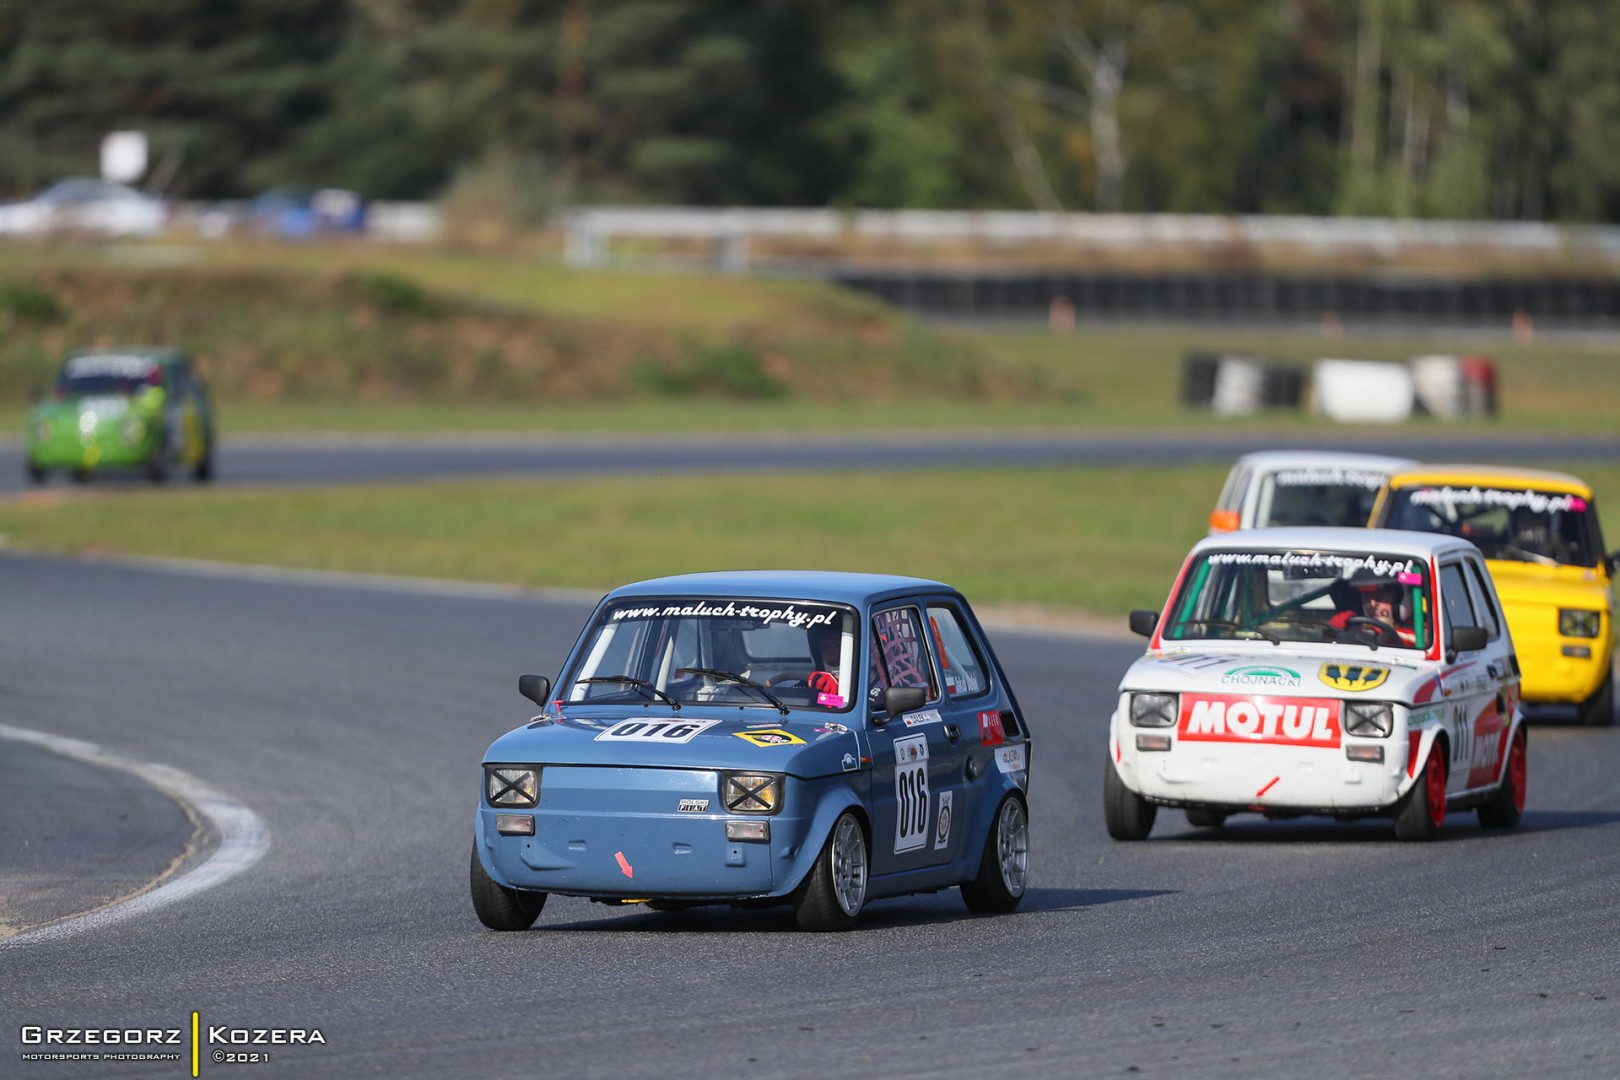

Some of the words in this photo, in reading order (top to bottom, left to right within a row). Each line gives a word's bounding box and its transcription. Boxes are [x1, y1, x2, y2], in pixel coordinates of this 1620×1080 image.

[1208, 552, 1413, 577] www.maluch-trophy.pl
[613, 601, 837, 628] www.maluch-trophy.pl
[1220, 674, 1301, 687] CHOJNACKI
[611, 722, 700, 739] 016
[1186, 701, 1333, 740] MOTUL
[1453, 704, 1468, 762] 011
[679, 804, 707, 812] FIAT
[899, 768, 928, 838] 016
